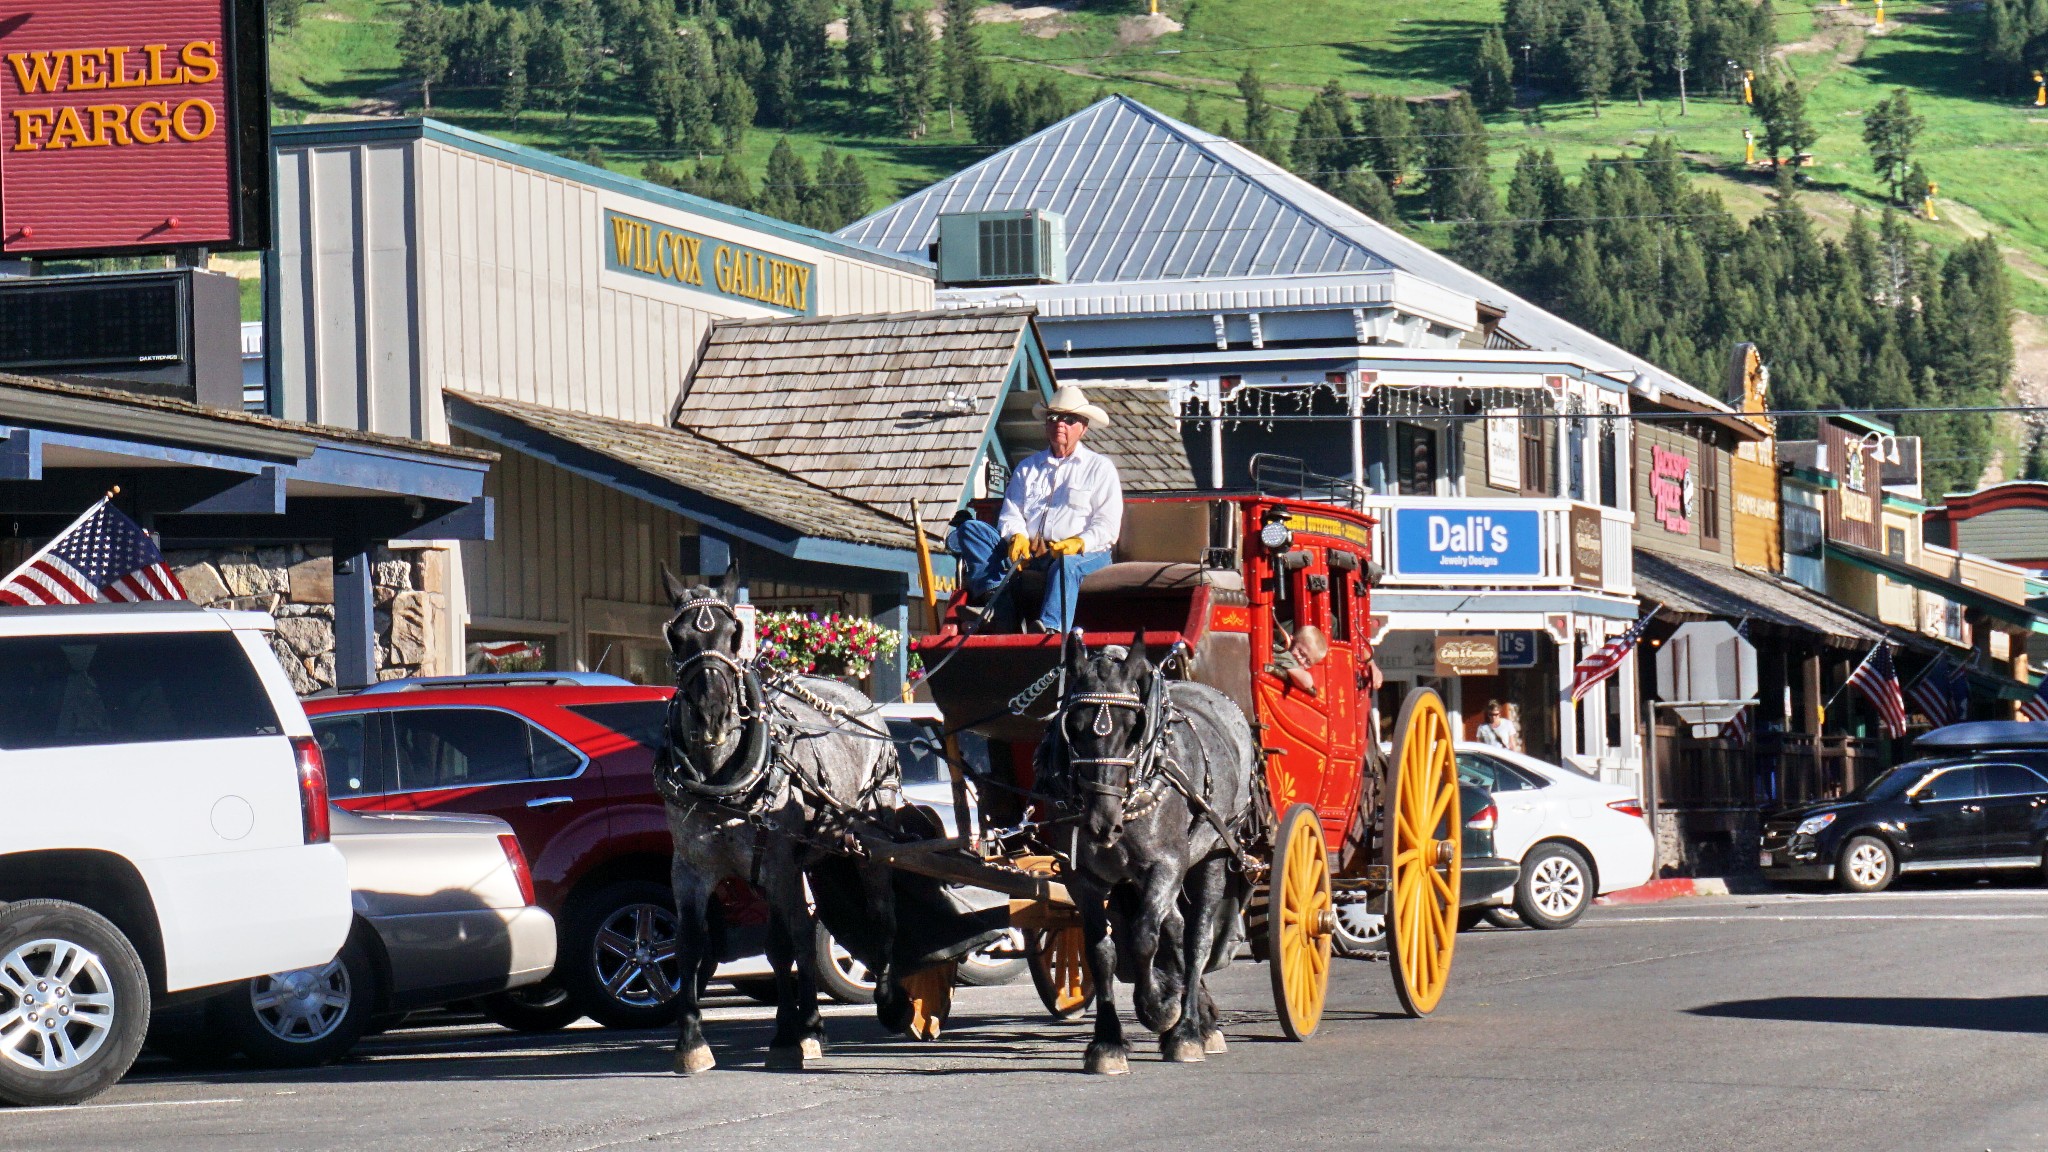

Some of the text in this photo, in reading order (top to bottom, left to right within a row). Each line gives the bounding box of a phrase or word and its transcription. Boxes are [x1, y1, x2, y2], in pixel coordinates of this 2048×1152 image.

[8, 41, 219, 93] WELLS
[13, 99, 217, 151] FARGO
[611, 216, 810, 311] WILCOX GALLERY
[1428, 515, 1508, 553] Dali's
[1439, 555, 1498, 568] Jewelry Designs
[1499, 631, 1526, 652] li's
